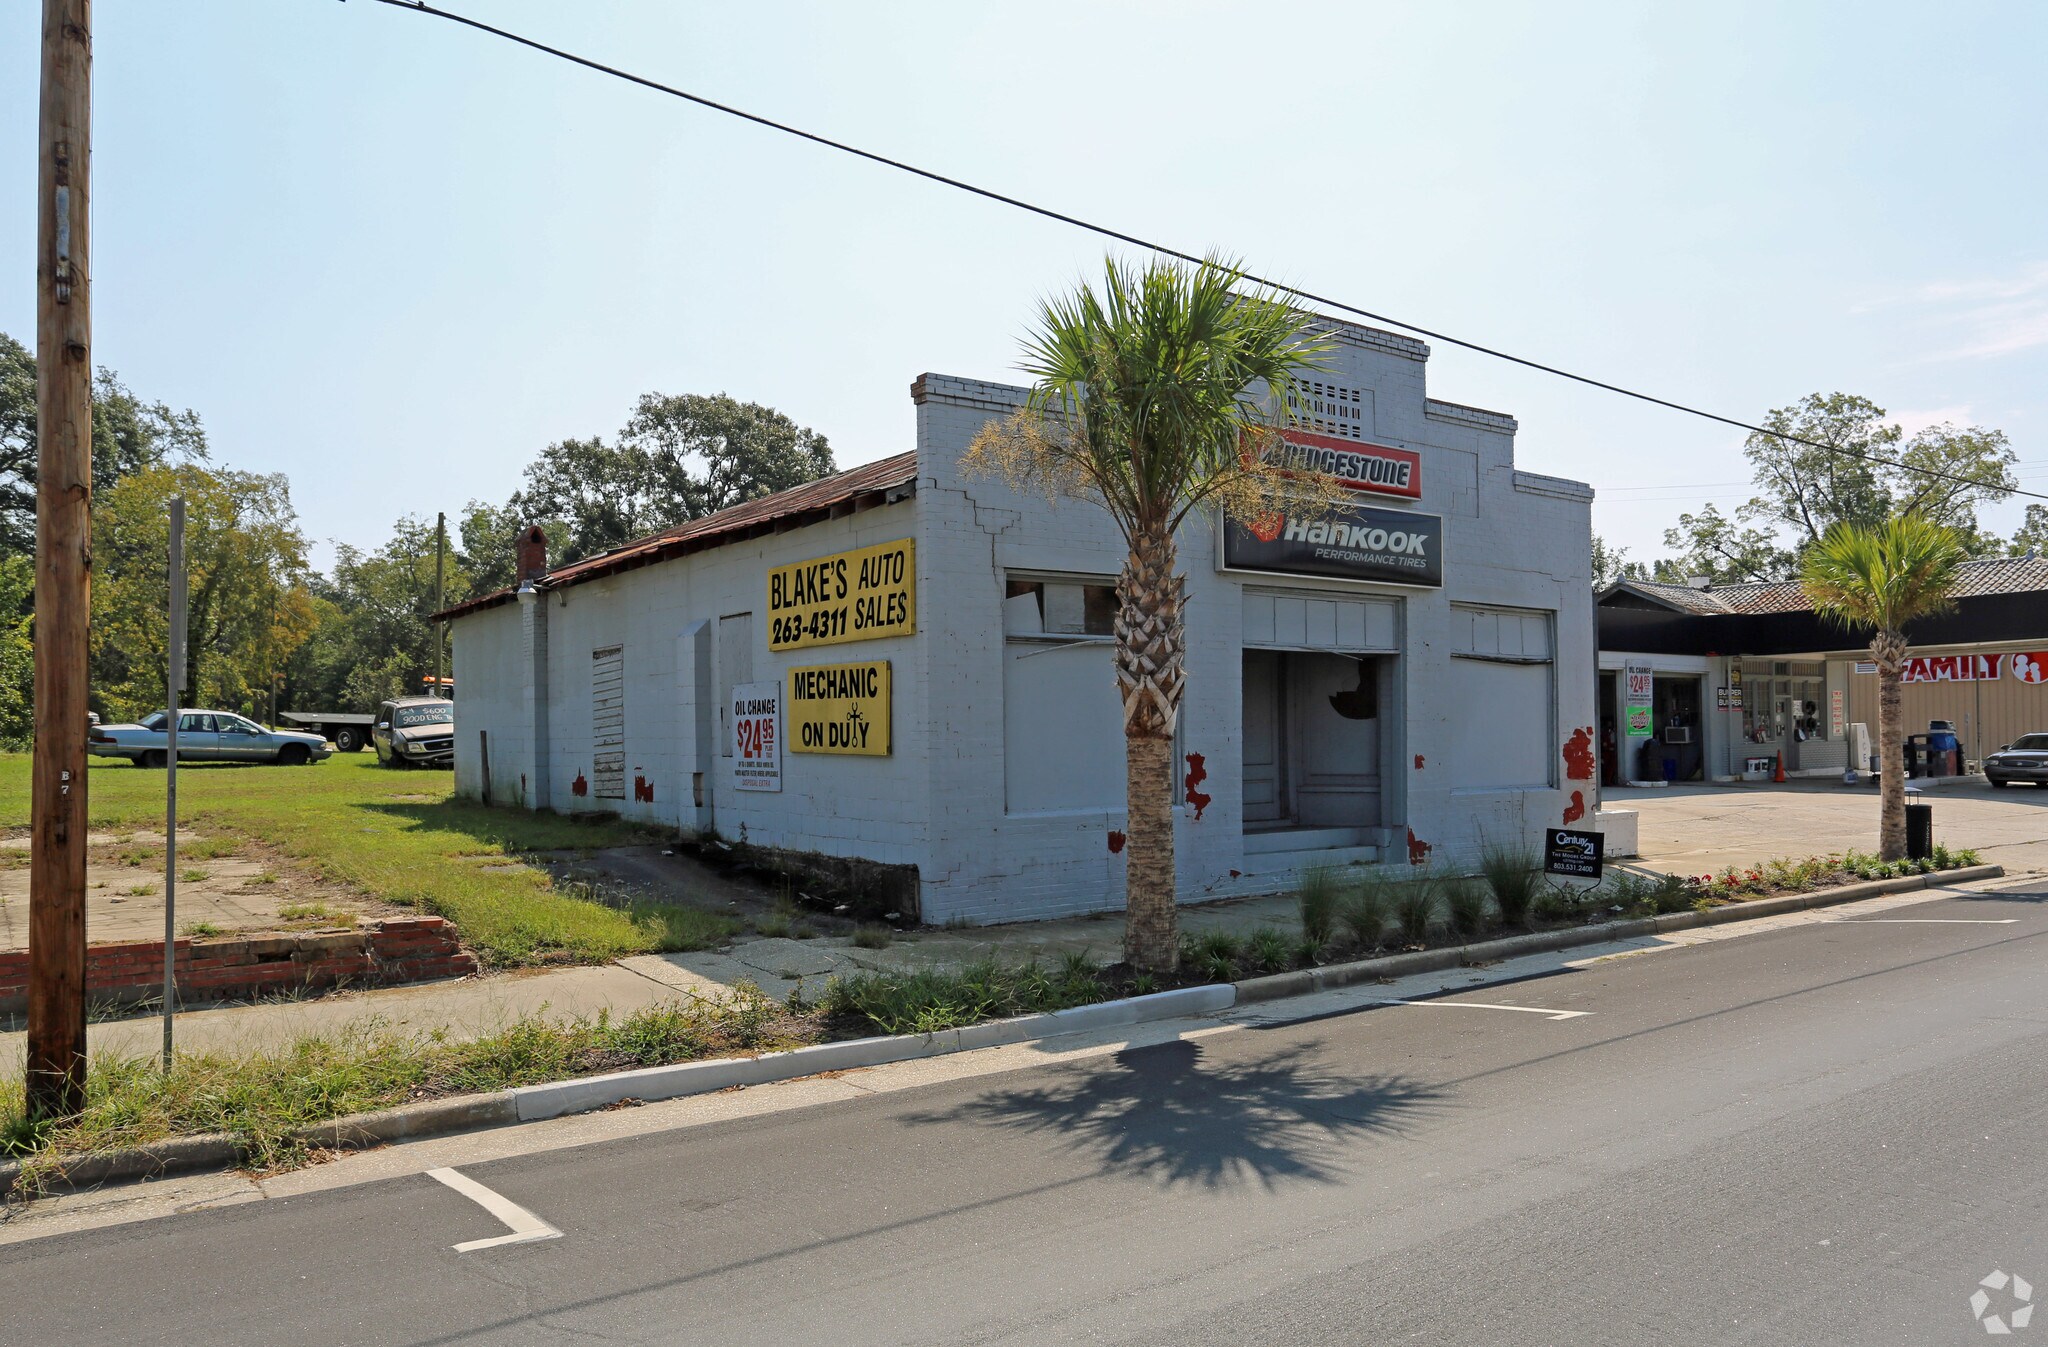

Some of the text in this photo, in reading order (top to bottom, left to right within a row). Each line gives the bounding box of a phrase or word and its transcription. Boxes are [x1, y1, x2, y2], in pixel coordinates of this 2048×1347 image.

[1315, 548, 1427, 568] PERFORMANCE TIRES
[771, 550, 905, 610] BLAKE'S AUTO
[772, 606, 848, 645] 263-4311
[794, 667, 878, 700] MECHANIC
[1718, 688, 1742, 697] BUPER
[735, 699, 776, 716] OIL CHANGE
[1718, 699, 1743, 707] BUPER
[802, 702, 870, 748] ON DUTY
[61, 770, 70, 781] B
[61, 785, 69, 795] 7
[1584, 843, 1594, 855] 21
